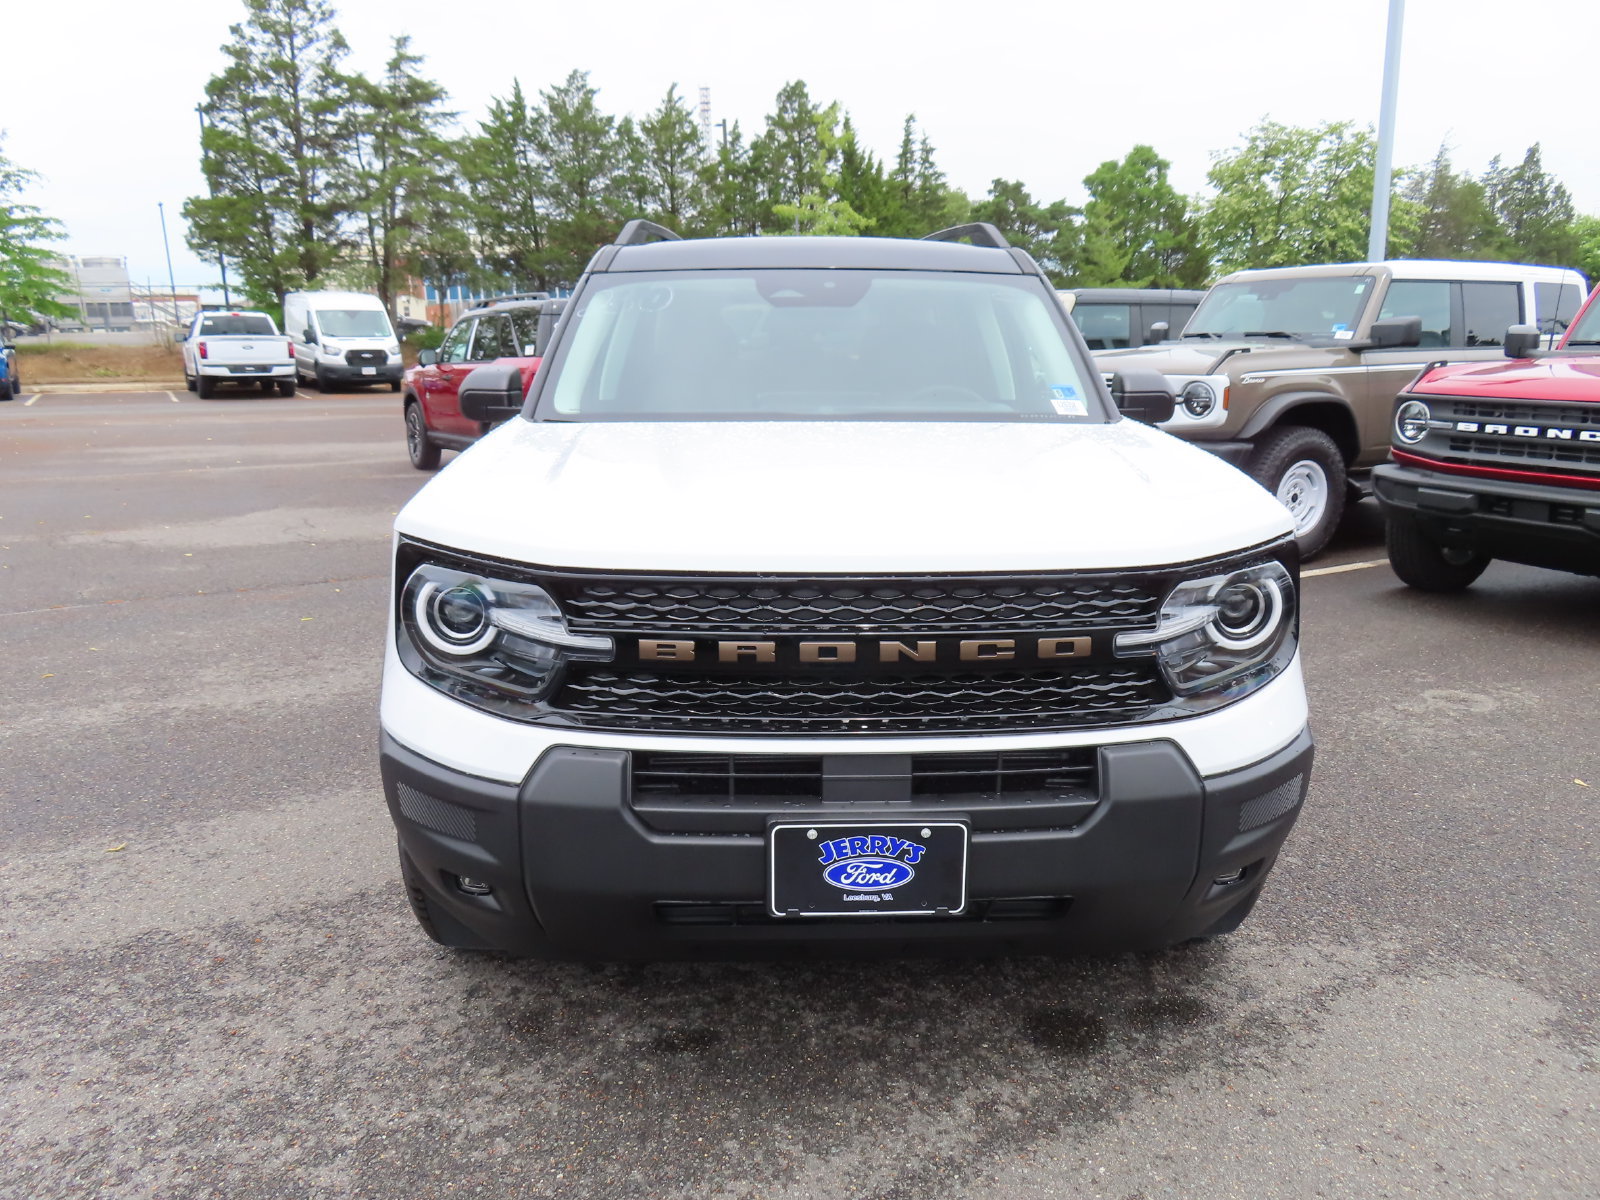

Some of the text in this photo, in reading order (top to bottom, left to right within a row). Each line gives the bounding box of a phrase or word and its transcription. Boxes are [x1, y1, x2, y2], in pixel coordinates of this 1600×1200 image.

[638, 636, 1092, 663] BRONCO
[818, 834, 926, 865] JERRY'S
[840, 863, 897, 885] Ford
[881, 893, 894, 901] VA
